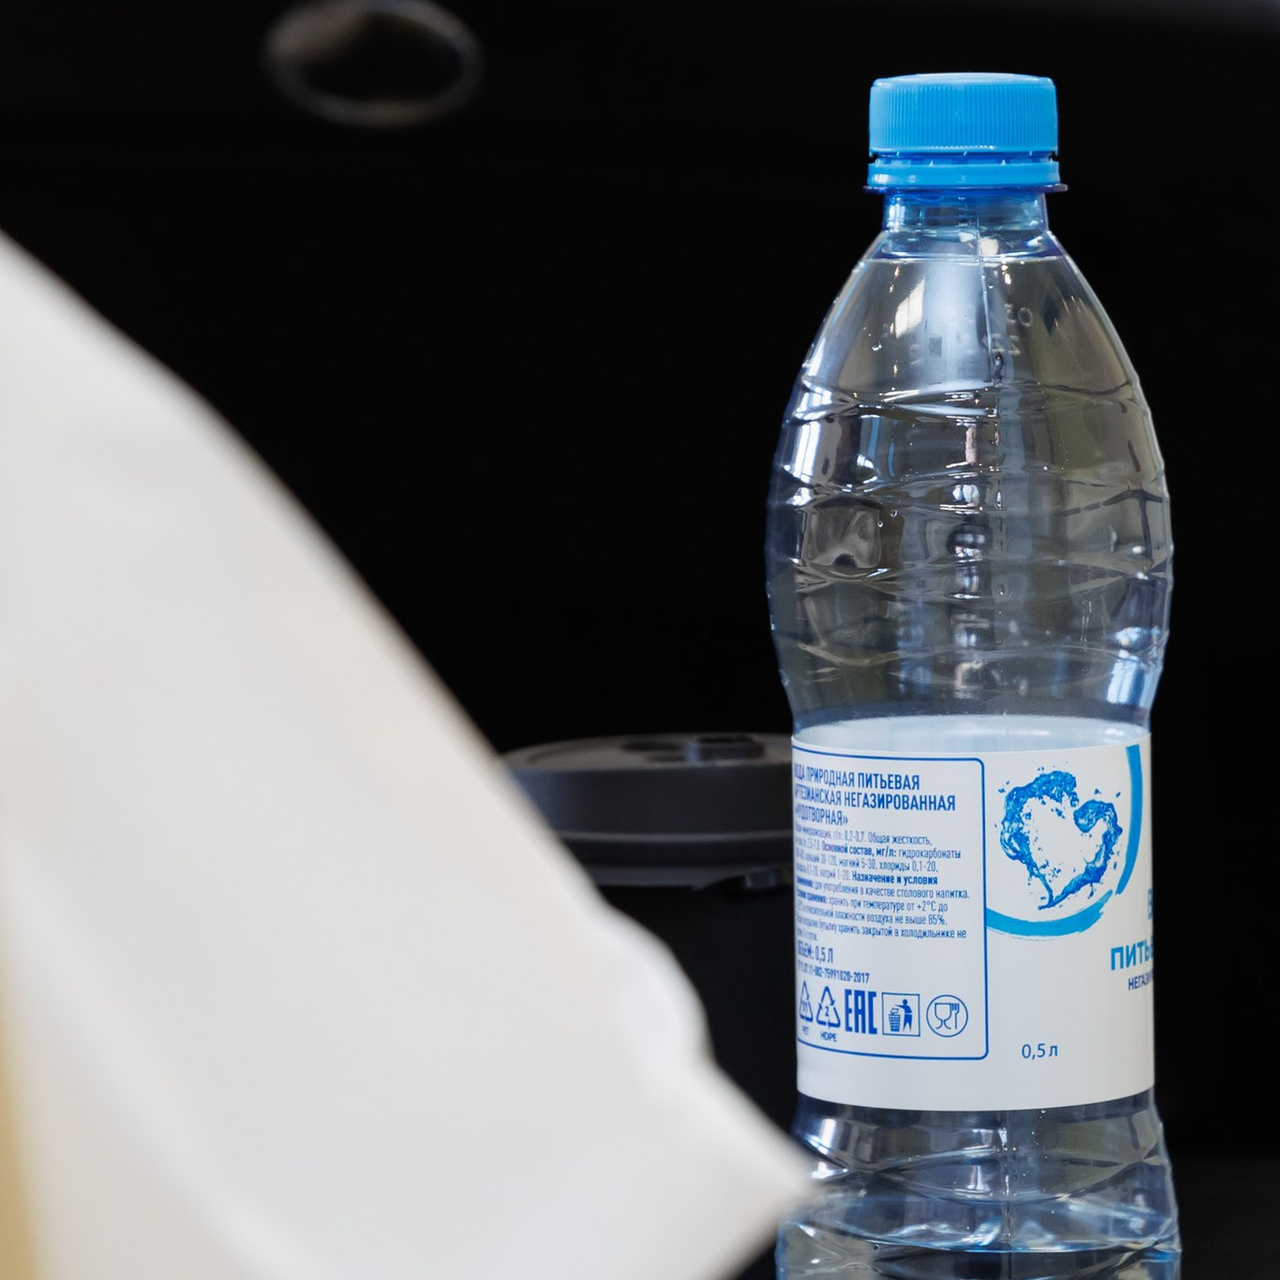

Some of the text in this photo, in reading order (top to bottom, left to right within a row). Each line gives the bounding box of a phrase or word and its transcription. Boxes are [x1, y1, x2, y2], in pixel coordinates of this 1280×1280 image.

[806, 766, 855, 788] ПРИРОДНАЯ
[857, 772, 920, 791] ПИТЬЕВАЯ
[844, 791, 956, 811] НЕГАЗИРОВАННАЯ
[868, 831, 890, 845] Общая
[892, 835, 932, 846] жесткость,
[822, 841, 848, 854] Основной
[849, 846, 875, 857] состав,
[876, 845, 896, 858] мг/л:
[898, 847, 961, 860] гидрокарбонаты
[879, 861, 910, 872] хлориды
[912, 860, 938, 872] 0,1-20,
[852, 870, 894, 884] Назначение
[896, 875, 901, 884] и
[903, 875, 938, 886] условия
[865, 887, 895, 897] качестве
[896, 888, 934, 898] столового
[936, 890, 970, 899] напитка.
[863, 900, 905, 913] температуре
[906, 902, 915, 911] от
[938, 903, 948, 913] до
[866, 913, 893, 925] воздуха
[894, 915, 903, 924] не
[905, 916, 926, 925] выше
[928, 914, 948, 926] 85%.
[861, 926, 893, 938] закрытой
[894, 928, 899, 937] в
[901, 928, 955, 939] холодильнике
[957, 929, 967, 938] не
[815, 946, 826, 963] 0,5
[827, 947, 834, 964] Л
[1021, 1042, 1058, 1061] 0,5 л
